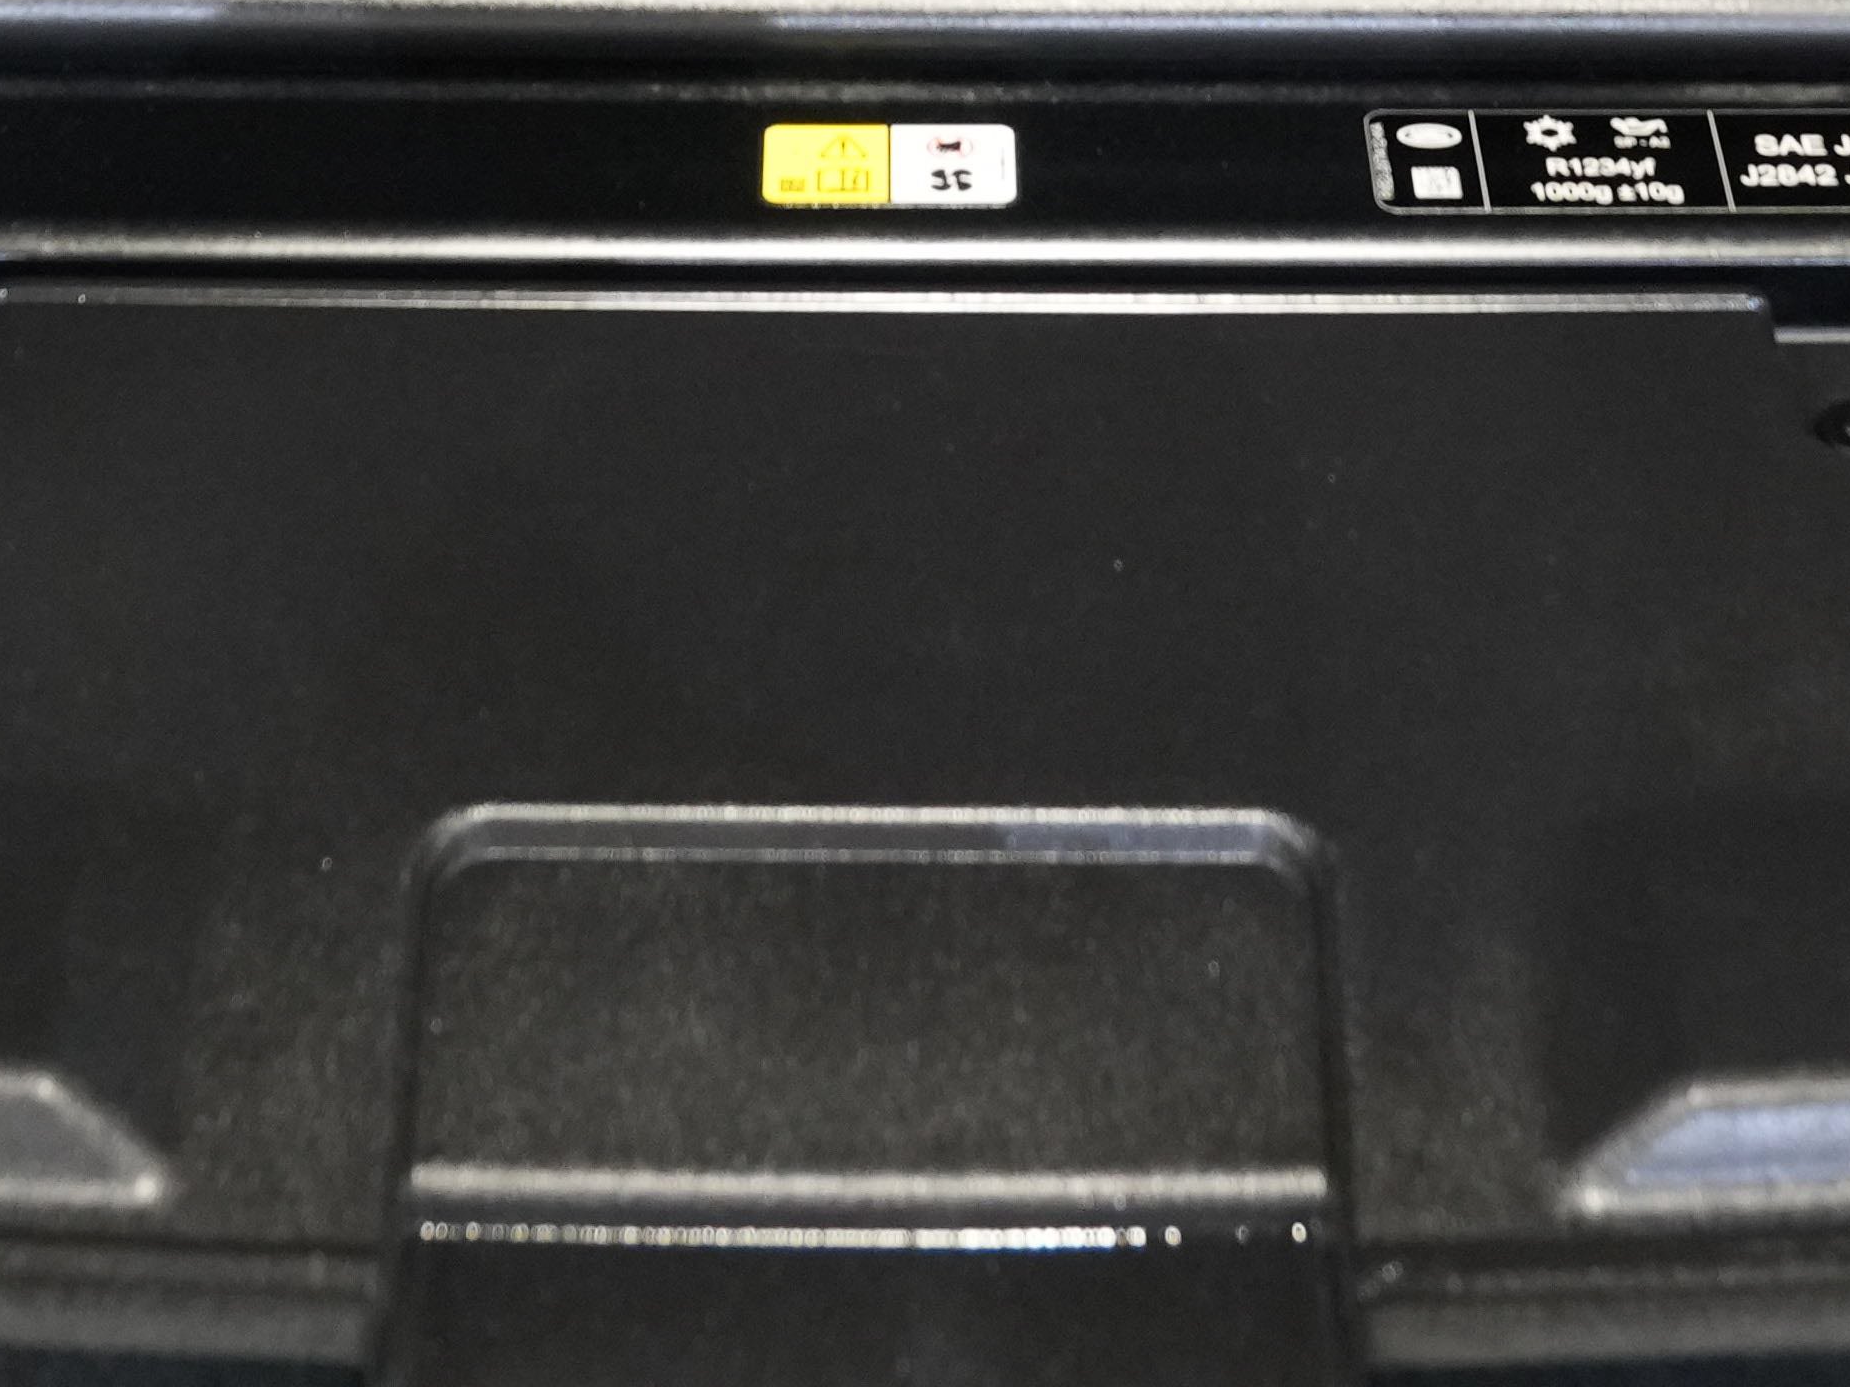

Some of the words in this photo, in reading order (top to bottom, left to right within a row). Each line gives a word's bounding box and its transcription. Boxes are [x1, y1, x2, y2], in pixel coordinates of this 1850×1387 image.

[1754, 133, 1828, 157] SAE
[1545, 156, 1656, 180] R1234yf
[1530, 181, 1614, 205] 1000g
